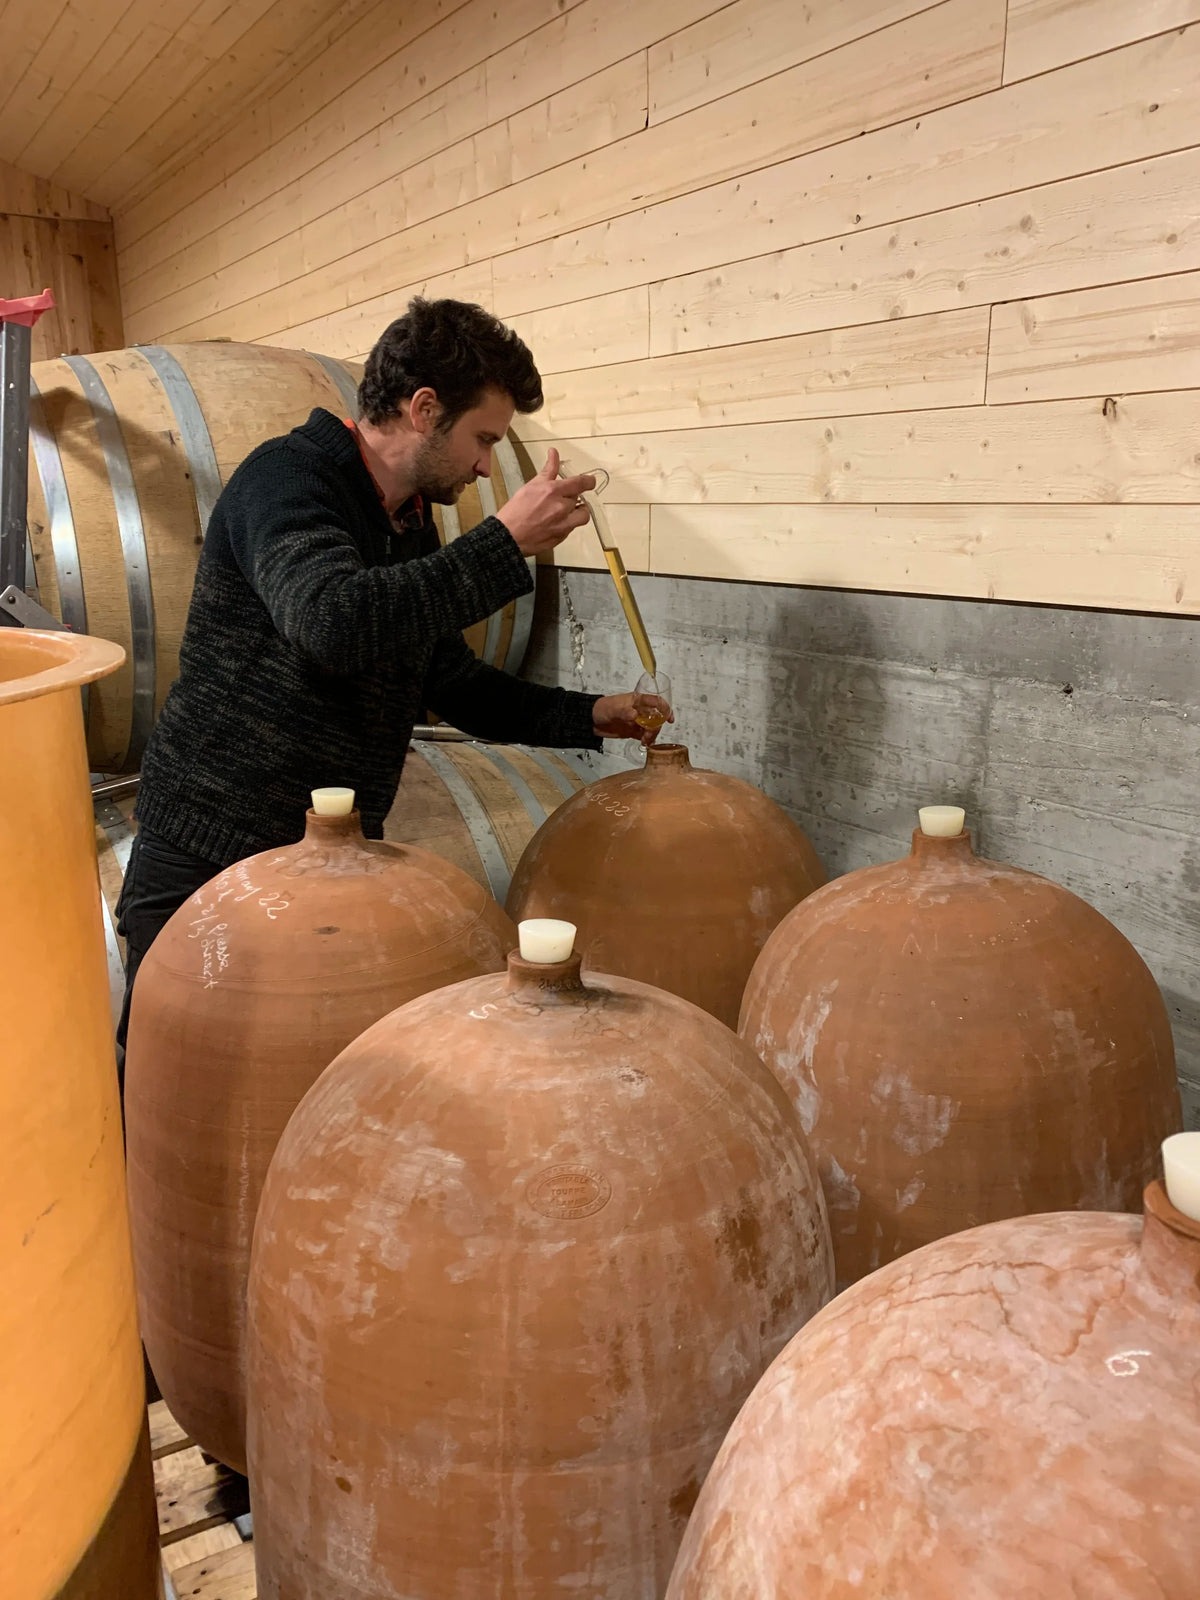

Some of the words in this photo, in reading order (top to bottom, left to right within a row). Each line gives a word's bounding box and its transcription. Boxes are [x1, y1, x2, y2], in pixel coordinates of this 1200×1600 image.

[605, 801, 631, 817] 22
[258, 892, 290, 920] 22
[1104, 1350, 1152, 1377] 6
